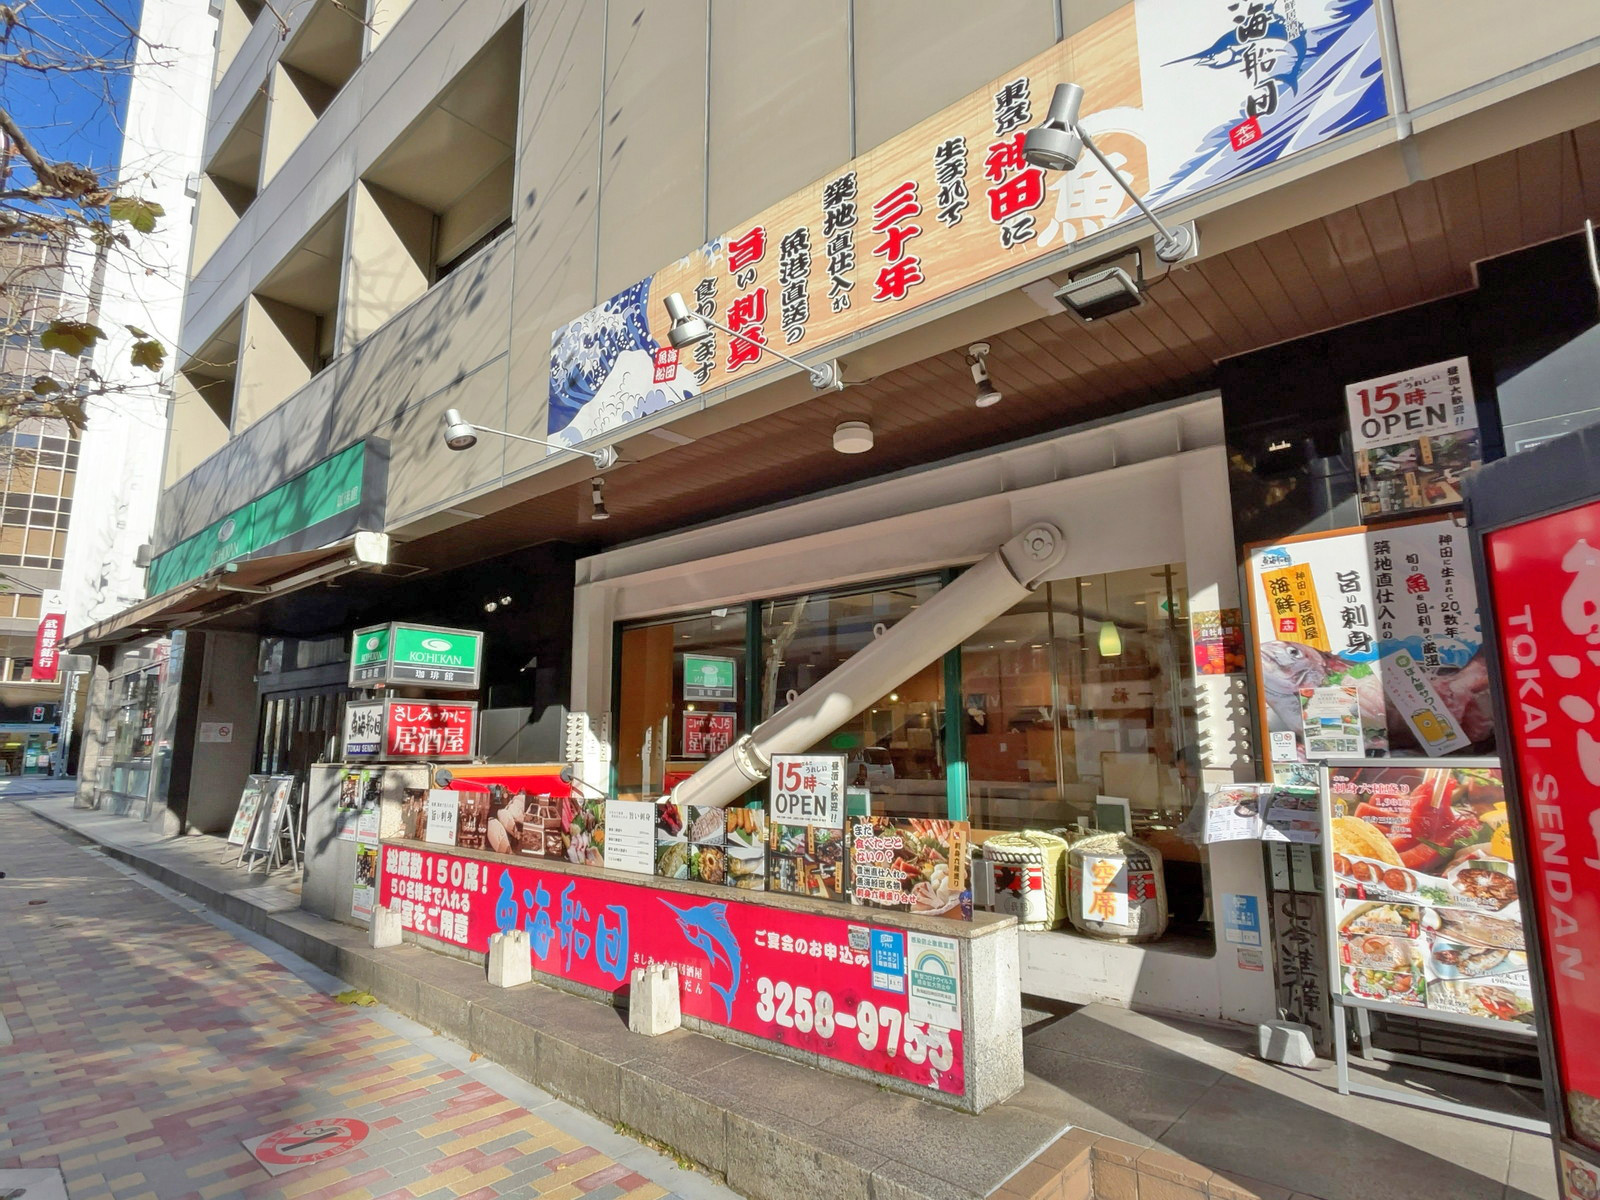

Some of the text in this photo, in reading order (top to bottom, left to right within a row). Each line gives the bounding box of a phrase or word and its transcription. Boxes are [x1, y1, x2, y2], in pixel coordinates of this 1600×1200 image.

[984, 78, 1043, 248] 東京神田に
[1233, 125, 1256, 147] 本店
[935, 137, 968, 226] 生まれて
[823, 172, 857, 312] 築地直仕入れ
[872, 181, 924, 300] 三十年
[726, 226, 768, 372] 旨い刺身
[1361, 403, 1447, 438] OPEN
[1269, 577, 1296, 615] 海鮮
[1296, 571, 1319, 640] 神田の居酒屋
[1336, 570, 1373, 654] 旨い刺身
[1373, 540, 1396, 639] 築地直仕入れの
[415, 669, 455, 682] 珈琲館
[1508, 604, 1551, 749] TOKAI
[393, 725, 464, 754] 居酒屋
[775, 793, 827, 816] OPEN
[854, 825, 873, 836] まだ
[854, 838, 903, 850] 食べたこと
[391, 877, 470, 913] 50名様まで入れる
[1089, 861, 1117, 920] 空席
[1532, 773, 1585, 982] SENDAN
